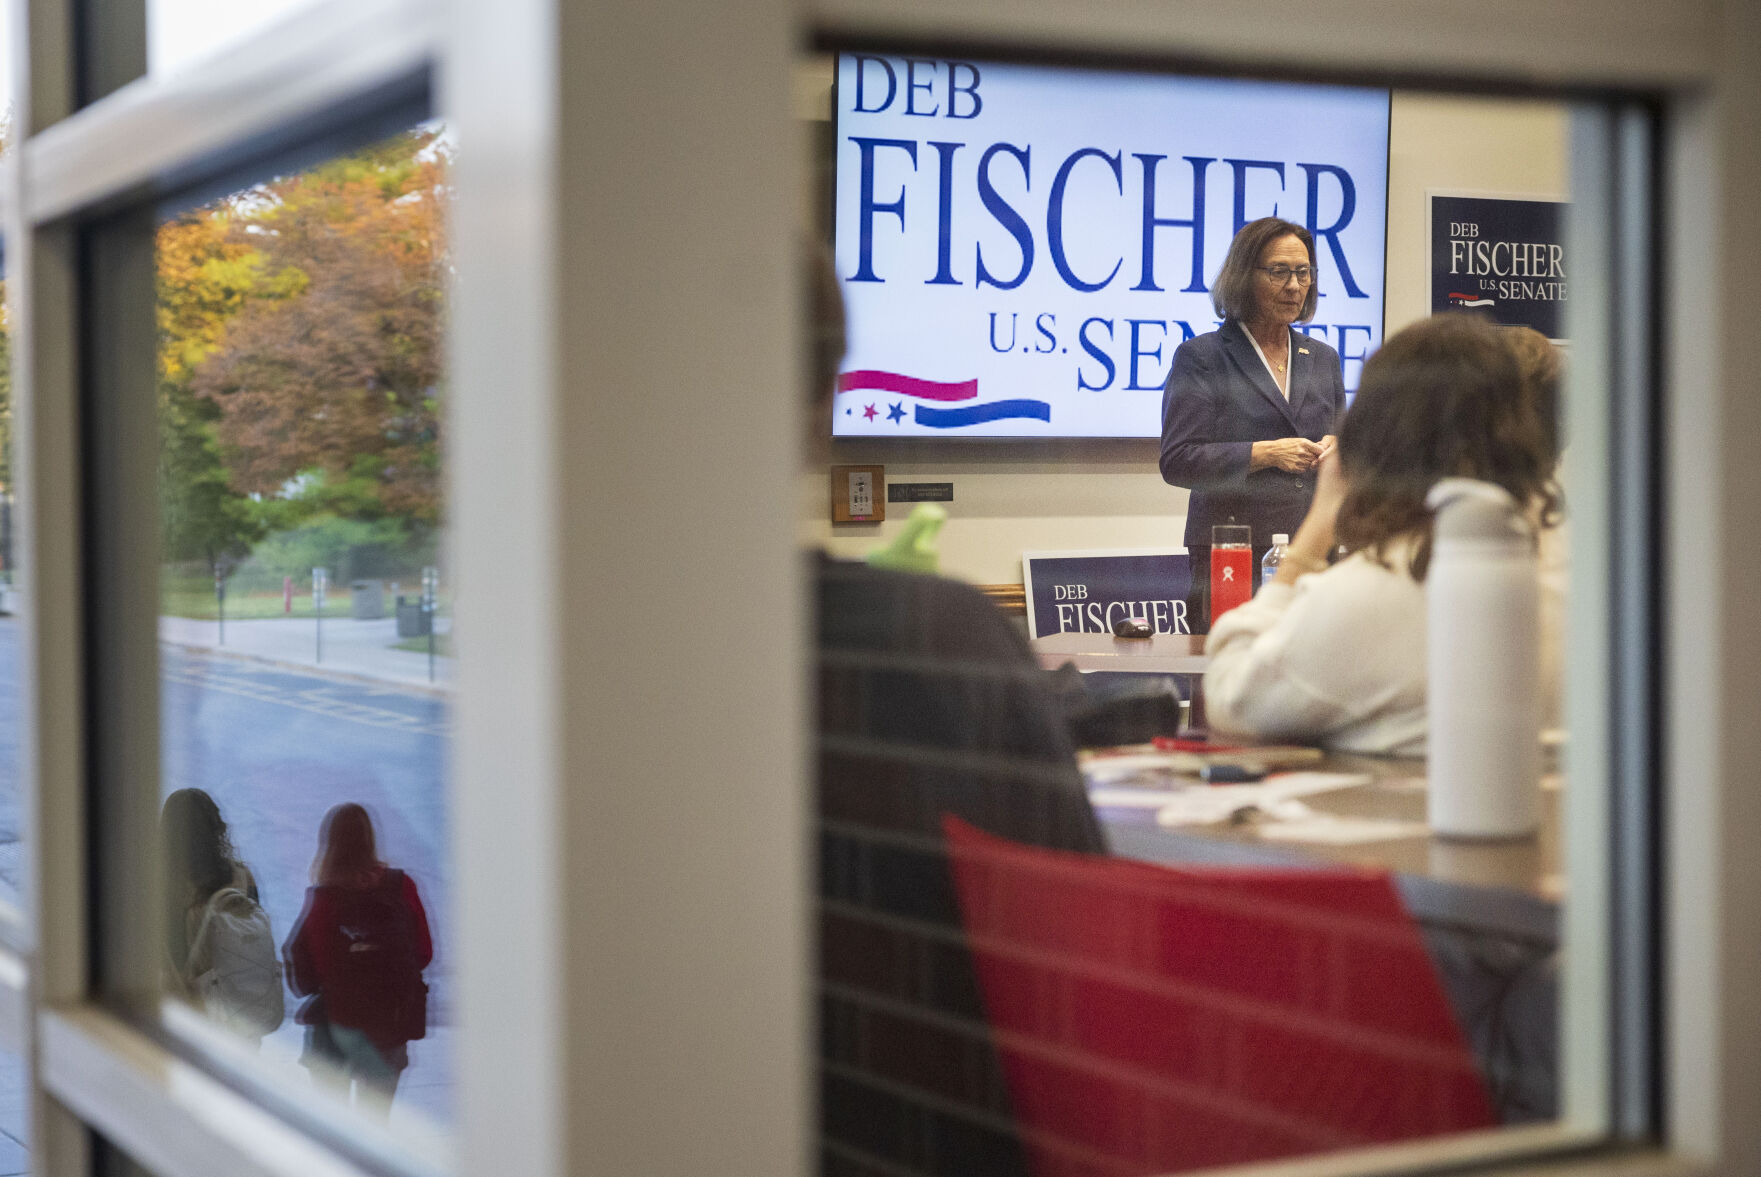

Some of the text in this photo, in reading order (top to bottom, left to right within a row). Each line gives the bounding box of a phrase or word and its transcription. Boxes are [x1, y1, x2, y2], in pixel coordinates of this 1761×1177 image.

[852, 54, 983, 120] DEB
[1450, 222, 1479, 237] DEB
[1449, 240, 1566, 277] FISCHER
[1479, 279, 1568, 301] U.S. SENATE
[989, 312, 1067, 355] U.S.
[1054, 584, 1088, 601] DEB
